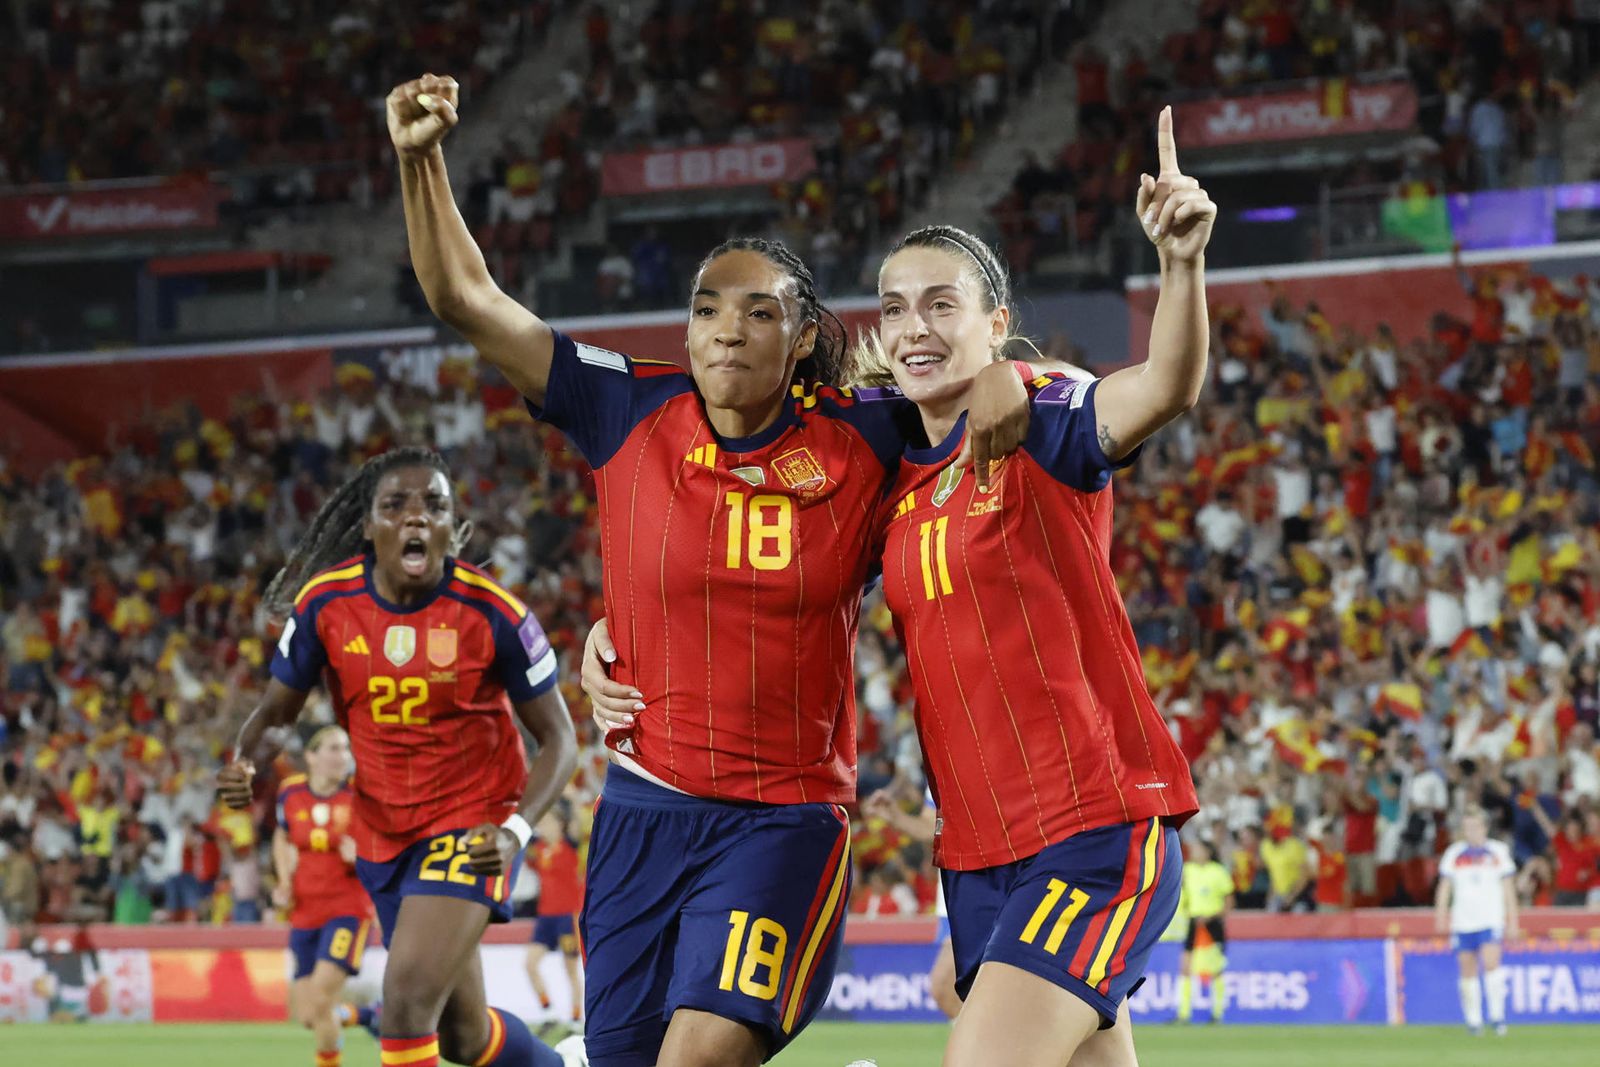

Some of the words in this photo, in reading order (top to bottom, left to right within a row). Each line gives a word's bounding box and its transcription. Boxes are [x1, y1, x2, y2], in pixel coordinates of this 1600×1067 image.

[725, 491, 792, 571] 18
[919, 516, 954, 601] 11
[368, 676, 430, 725] 22
[419, 835, 485, 886] 22
[329, 926, 353, 960] 8
[1019, 878, 1091, 956] 11
[718, 910, 787, 1000] 18
[1127, 971, 1309, 1012] QUALFIERS
